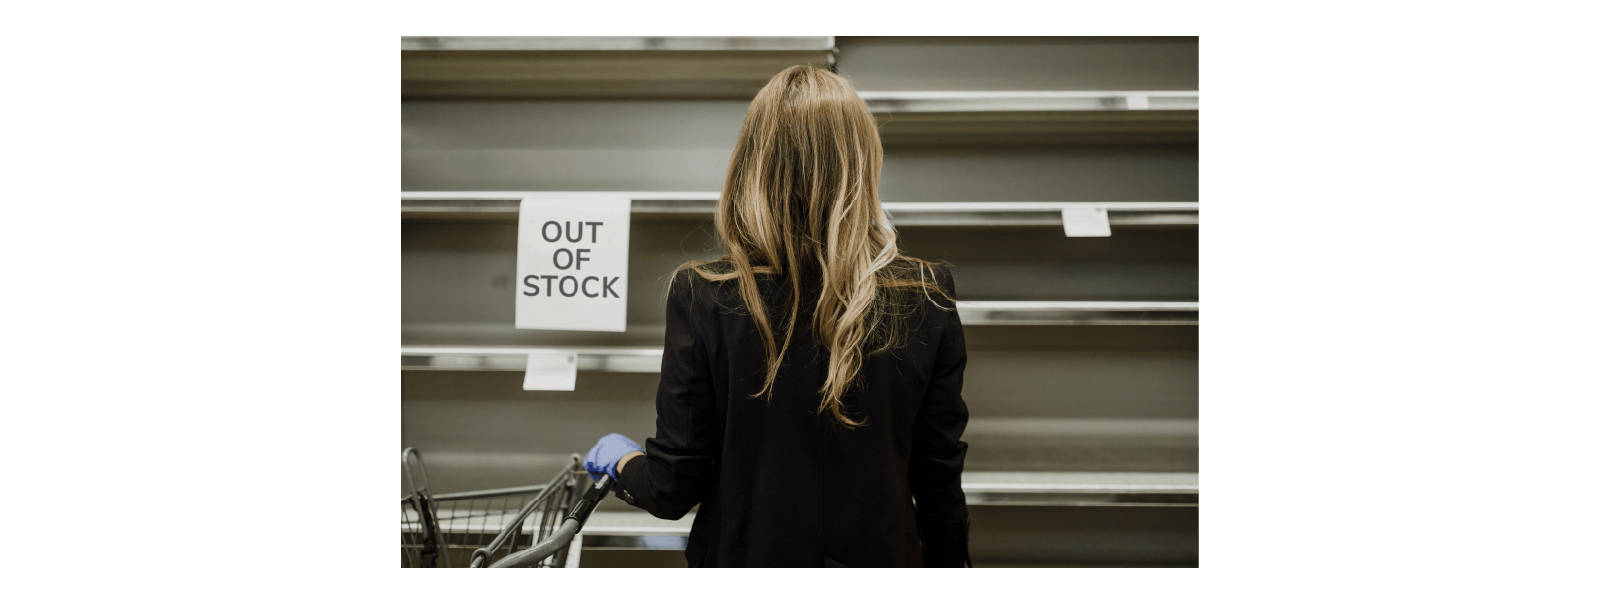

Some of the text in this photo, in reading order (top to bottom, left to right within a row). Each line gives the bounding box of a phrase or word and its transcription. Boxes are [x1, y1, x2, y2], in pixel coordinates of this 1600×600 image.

[541, 221, 604, 244] OUT
[552, 248, 591, 271] OF
[523, 275, 620, 298] STOCK
